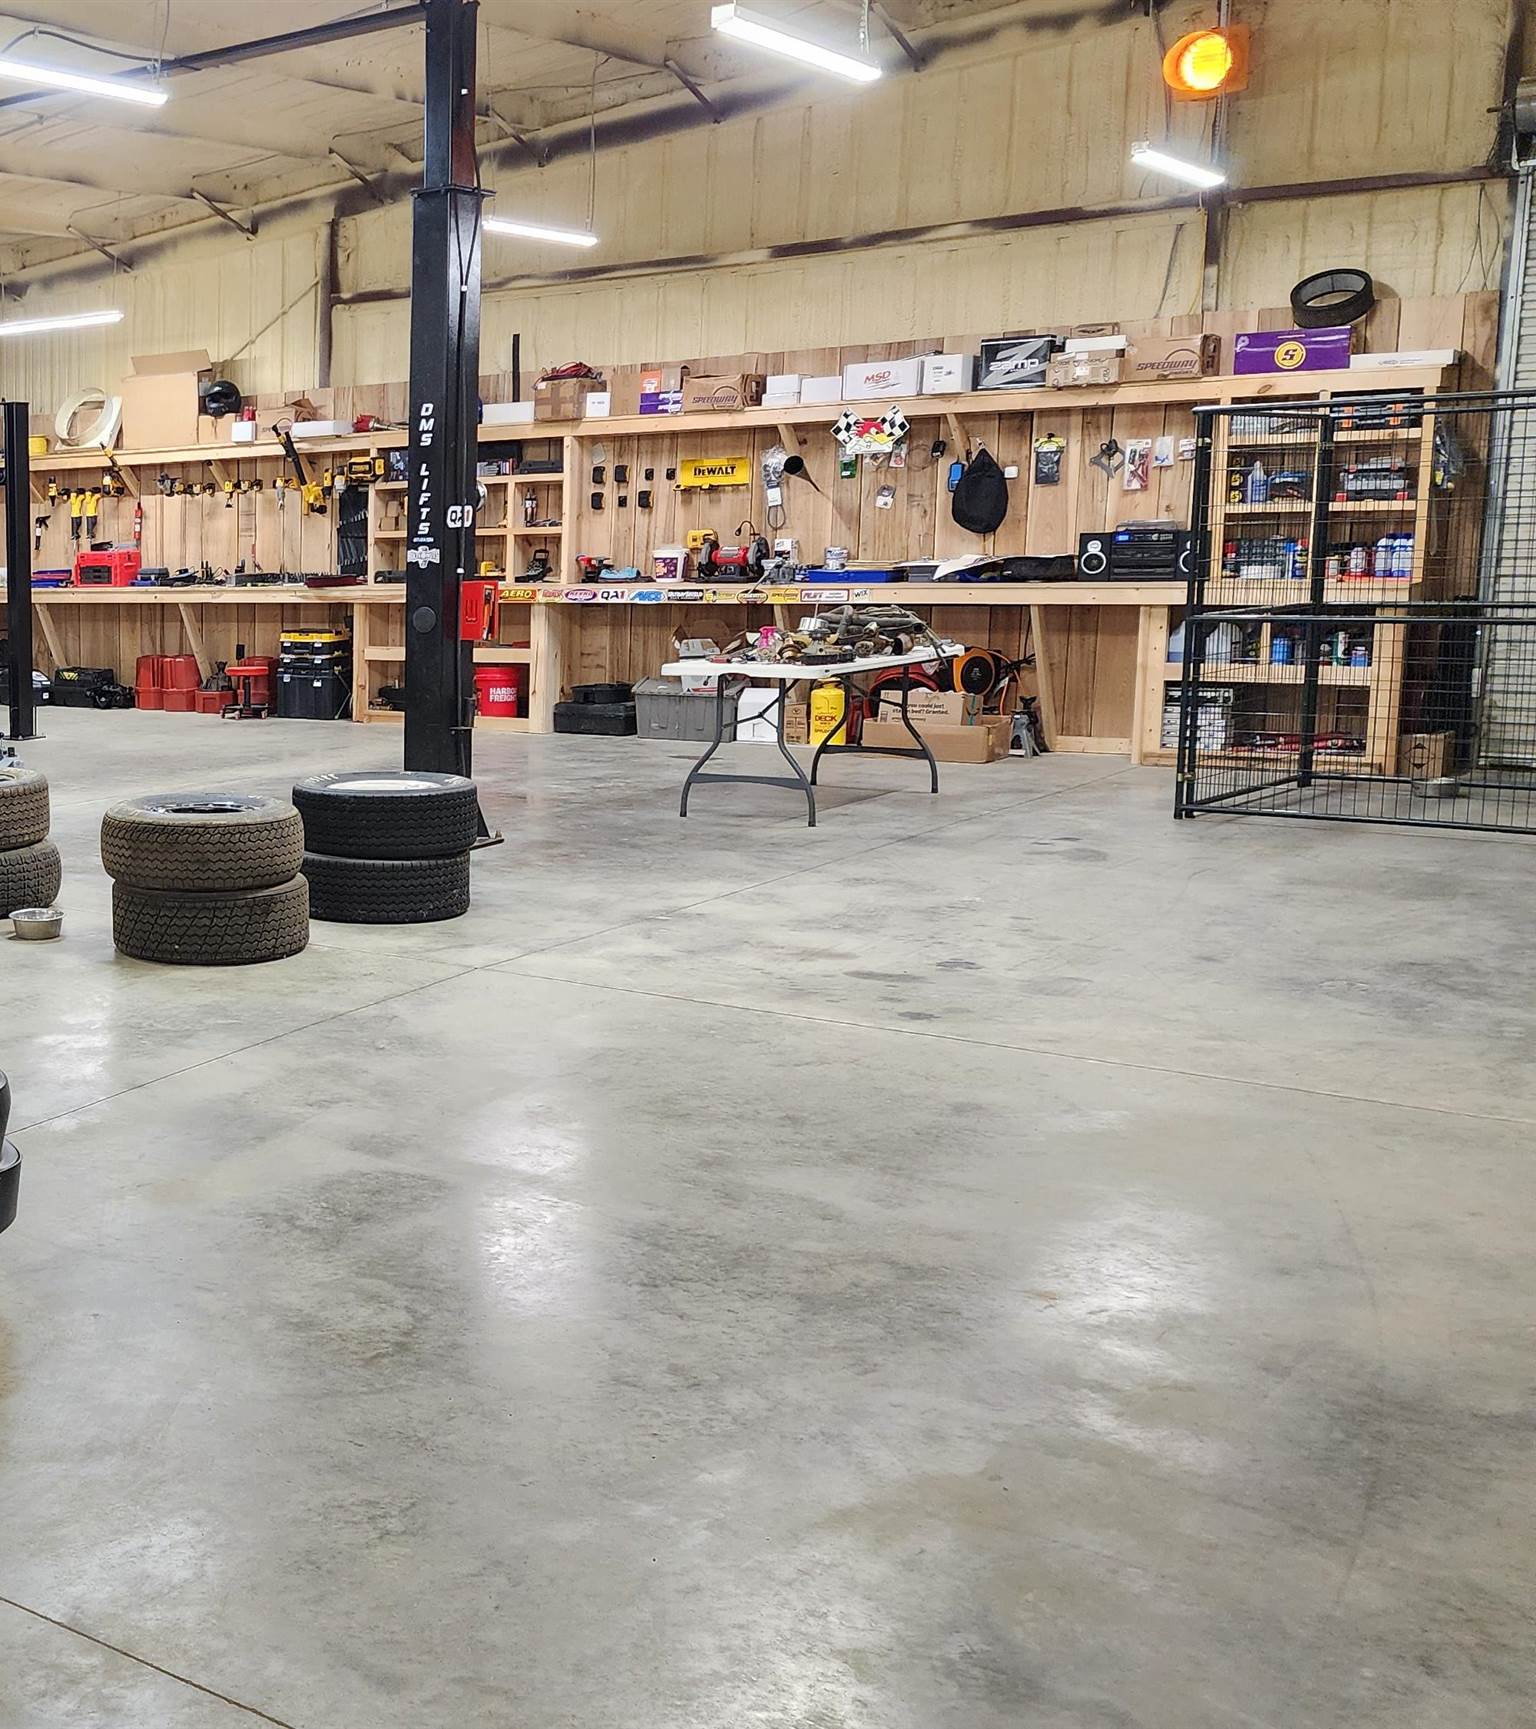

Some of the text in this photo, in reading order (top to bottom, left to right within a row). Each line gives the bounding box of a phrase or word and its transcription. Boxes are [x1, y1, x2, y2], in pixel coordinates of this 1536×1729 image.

[1136, 359, 1198, 371] SPEEDWAY
[864, 370, 892, 385] MSD
[418, 403, 434, 447] DMS
[417, 463, 431, 536] LIFTS
[500, 590, 533, 599] AERO
[600, 590, 625, 600] QA1
